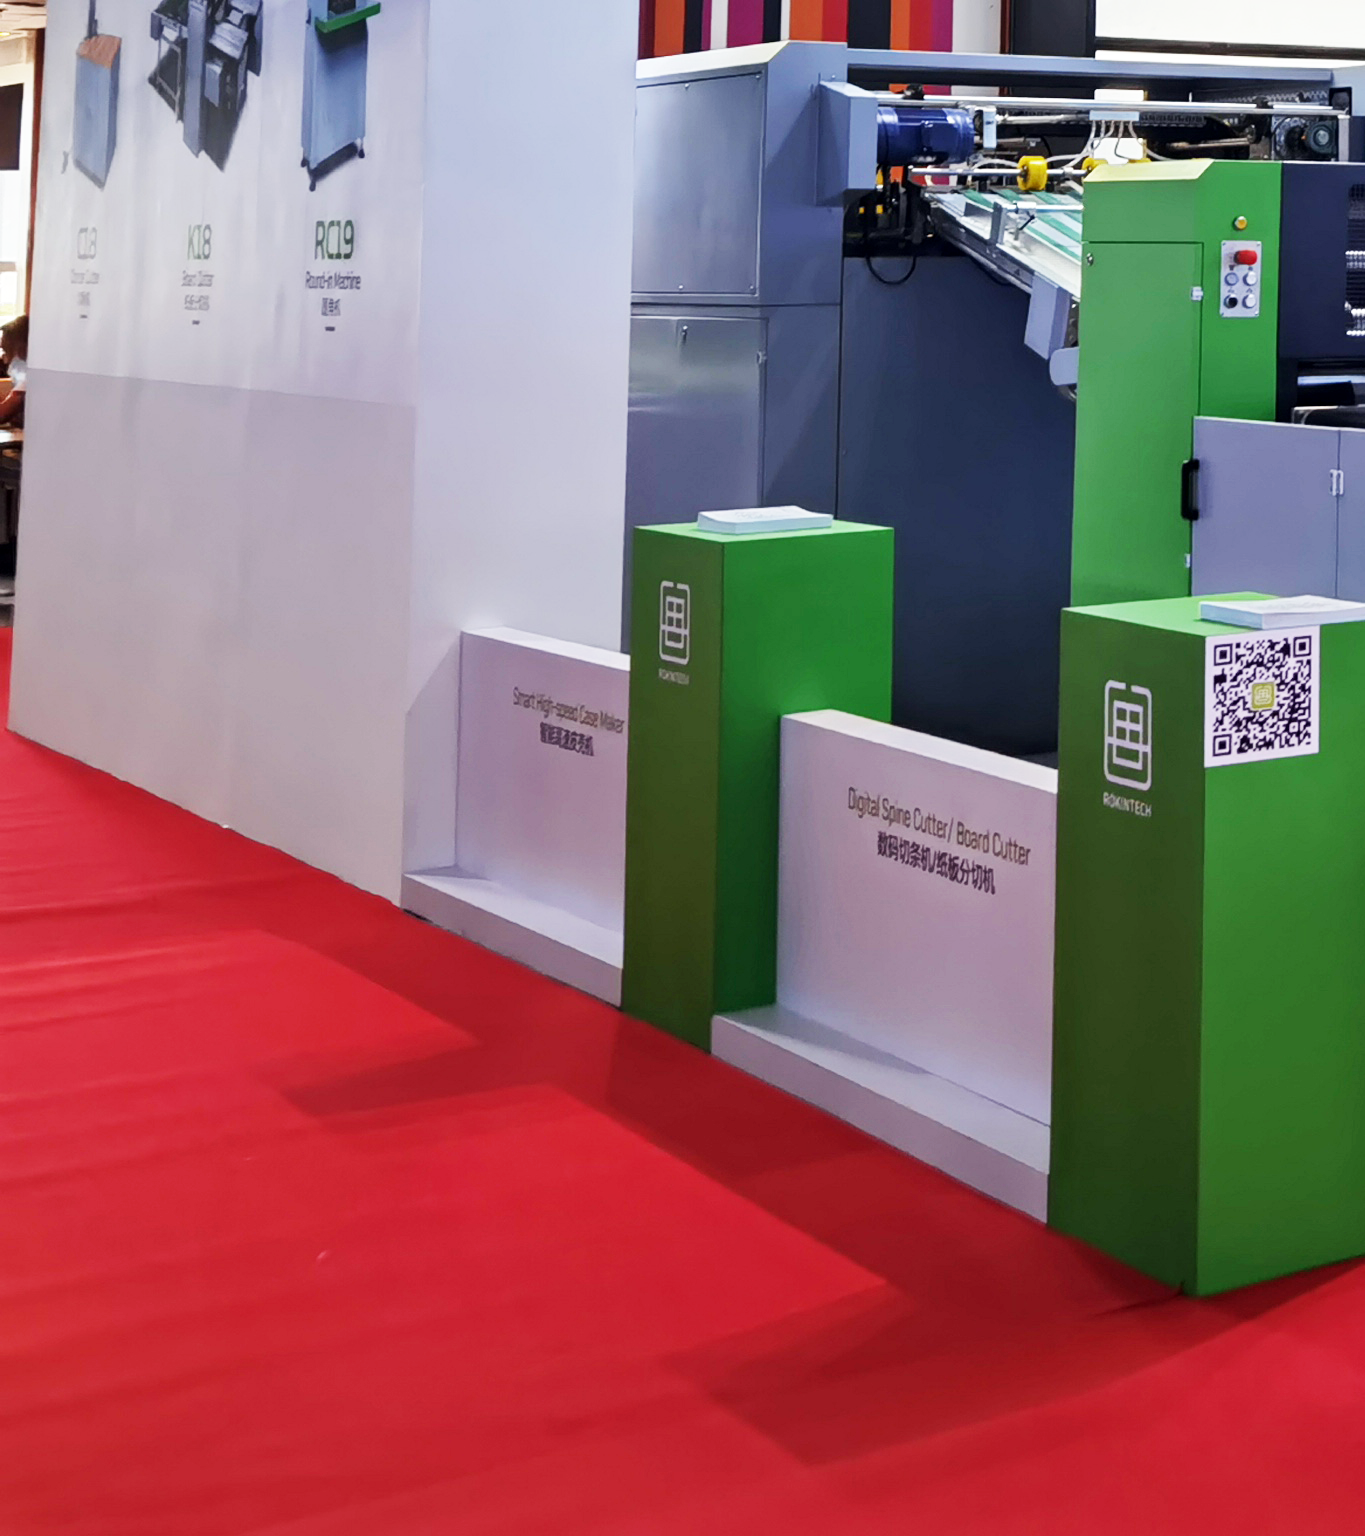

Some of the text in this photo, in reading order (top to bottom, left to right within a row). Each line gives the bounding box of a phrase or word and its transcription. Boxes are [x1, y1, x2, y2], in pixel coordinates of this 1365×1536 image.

[187, 223, 212, 261] K18
[314, 219, 355, 261] RC19
[1103, 791, 1152, 817] ROKINTECH
[848, 786, 881, 819] Digital
[882, 797, 911, 828] Spine
[956, 820, 990, 854] Board
[992, 832, 1032, 866] Cutter
